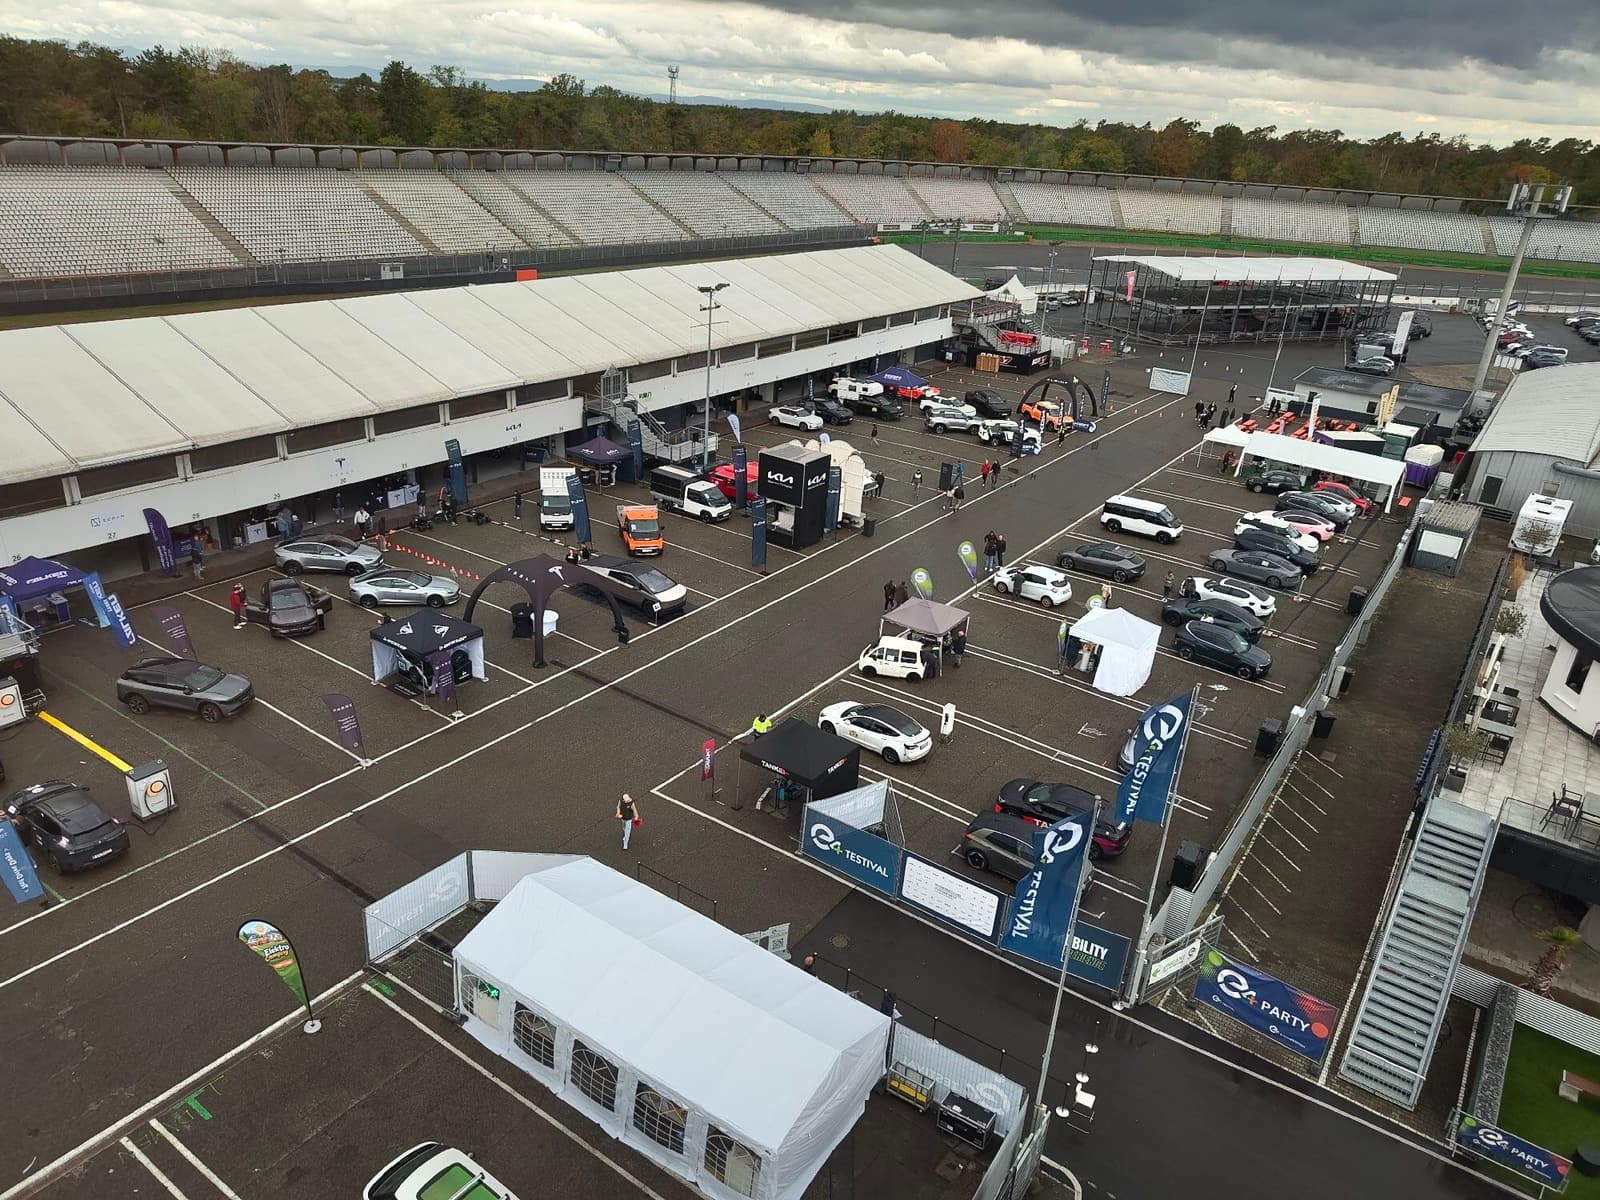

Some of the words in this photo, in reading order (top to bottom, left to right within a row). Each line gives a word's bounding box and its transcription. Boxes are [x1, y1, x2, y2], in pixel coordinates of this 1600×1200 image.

[107, 532, 117, 540] 27
[844, 850, 889, 878] TESTIVAL
[1071, 935, 1109, 964] BILITY
[1260, 1000, 1312, 1033] PARTY
[1510, 1147, 1550, 1169] PARTY
